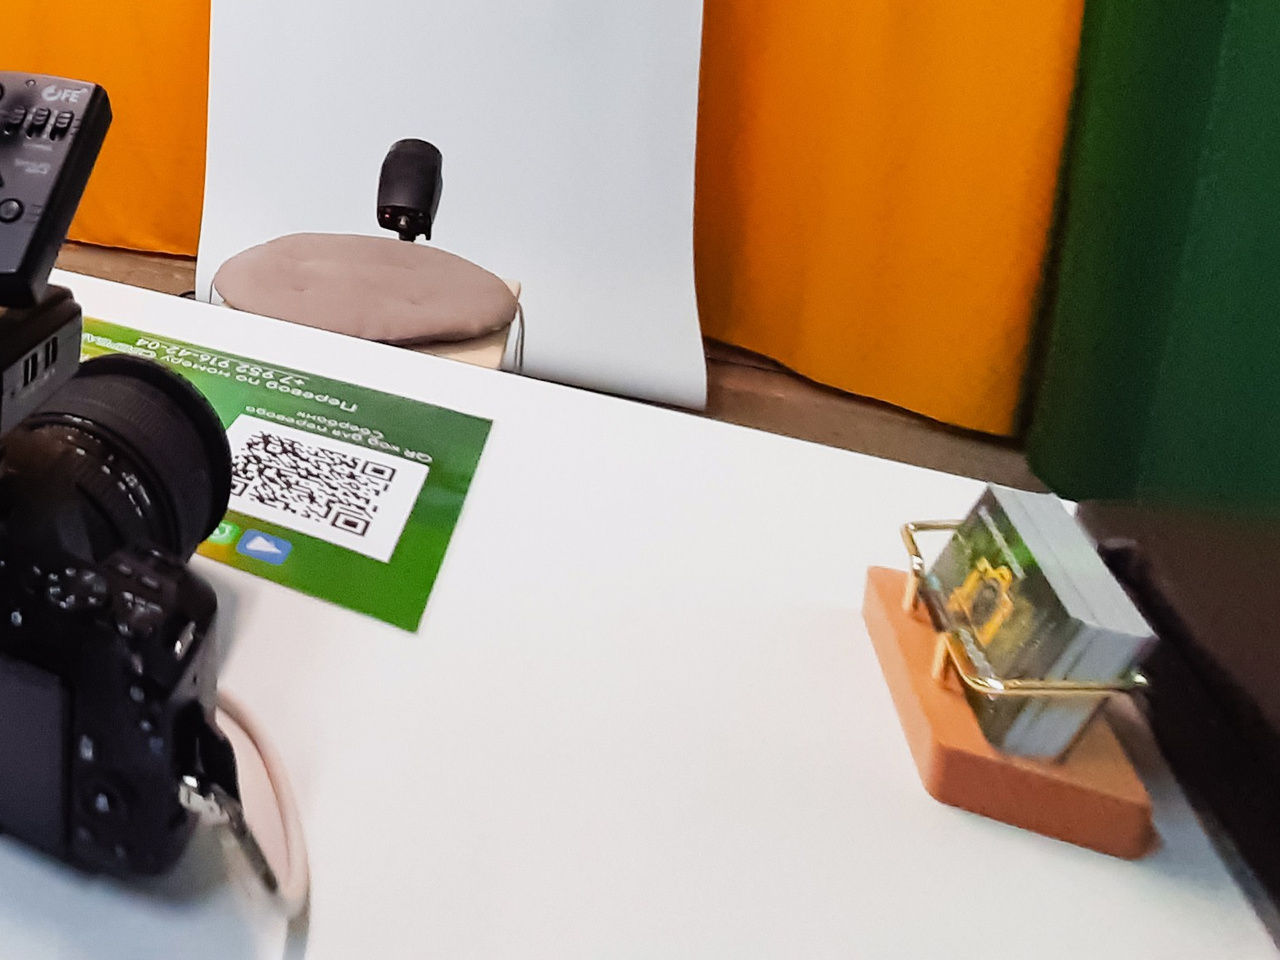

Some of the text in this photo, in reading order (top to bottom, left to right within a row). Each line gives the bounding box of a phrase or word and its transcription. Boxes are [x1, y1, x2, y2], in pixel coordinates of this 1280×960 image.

[135, 338, 306, 387] +7 952 916-42-04
[160, 355, 231, 378] номеру
[236, 373, 260, 386] по
[266, 381, 358, 413] Перевод
[245, 406, 433, 463] QR код для перевода
[296, 411, 384, 439] Сбербанк
